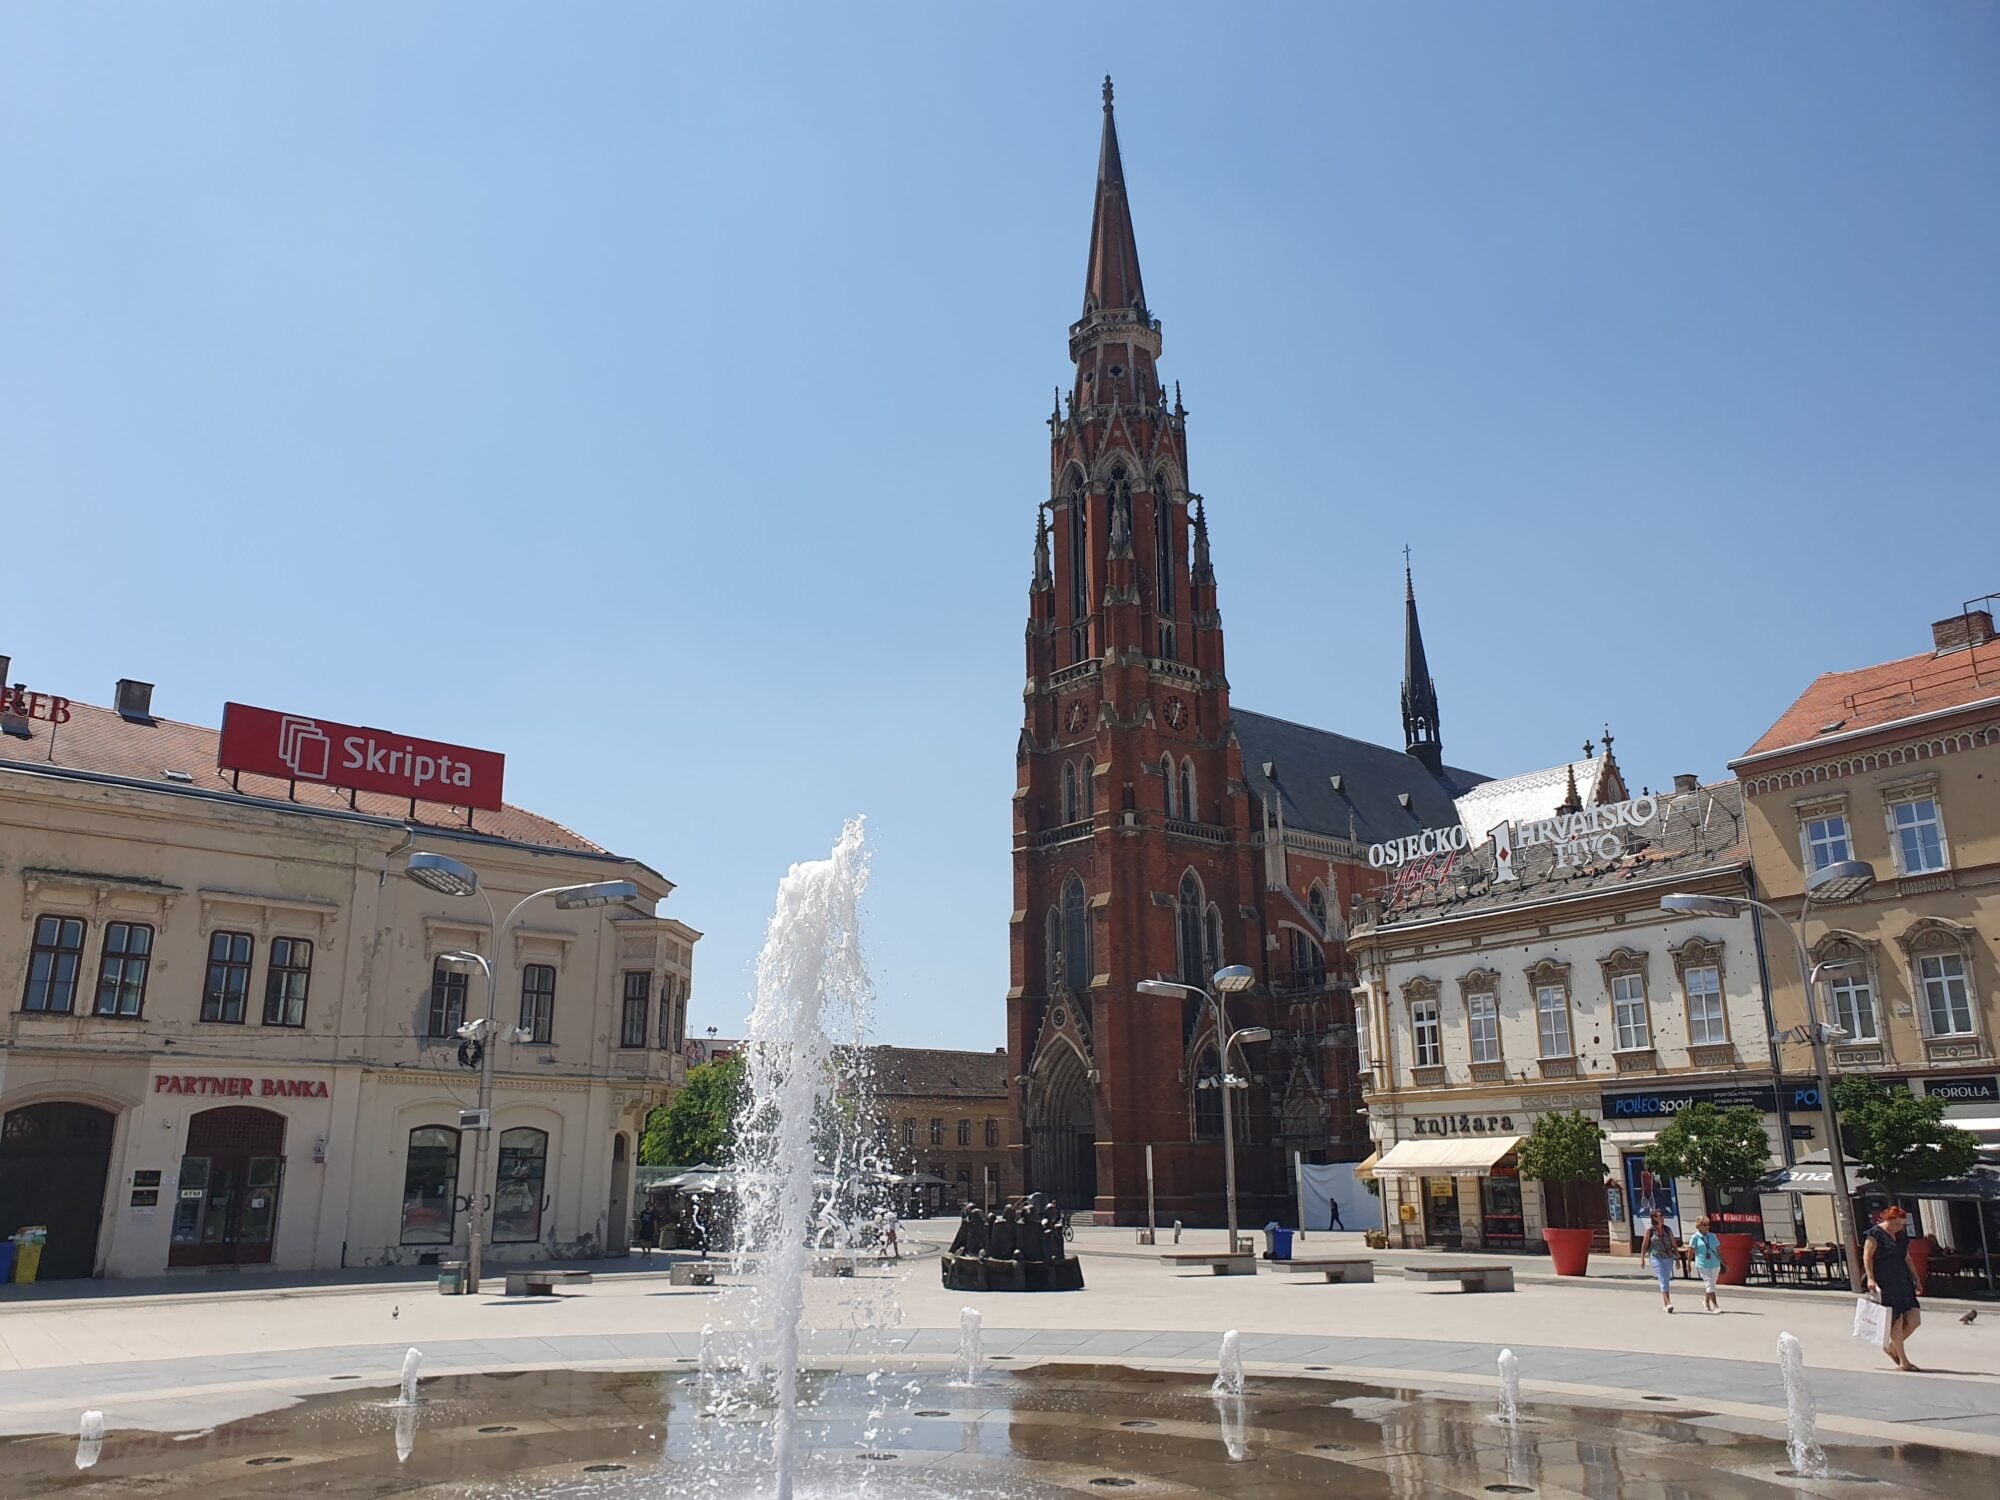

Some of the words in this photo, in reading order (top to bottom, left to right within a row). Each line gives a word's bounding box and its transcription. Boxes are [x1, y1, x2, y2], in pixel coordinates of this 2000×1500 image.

[342, 736, 472, 788] Skripta
[1514, 797, 1658, 849] HRVATSKO
[1369, 824, 1467, 868] OSJEČKO
[1393, 849, 1457, 896] 1664
[154, 1075, 253, 1097] PARTNER
[261, 1078, 329, 1098] BANKA
[1932, 1085, 1990, 1099] COROLLA
[1413, 1114, 1514, 1136] knjižara
